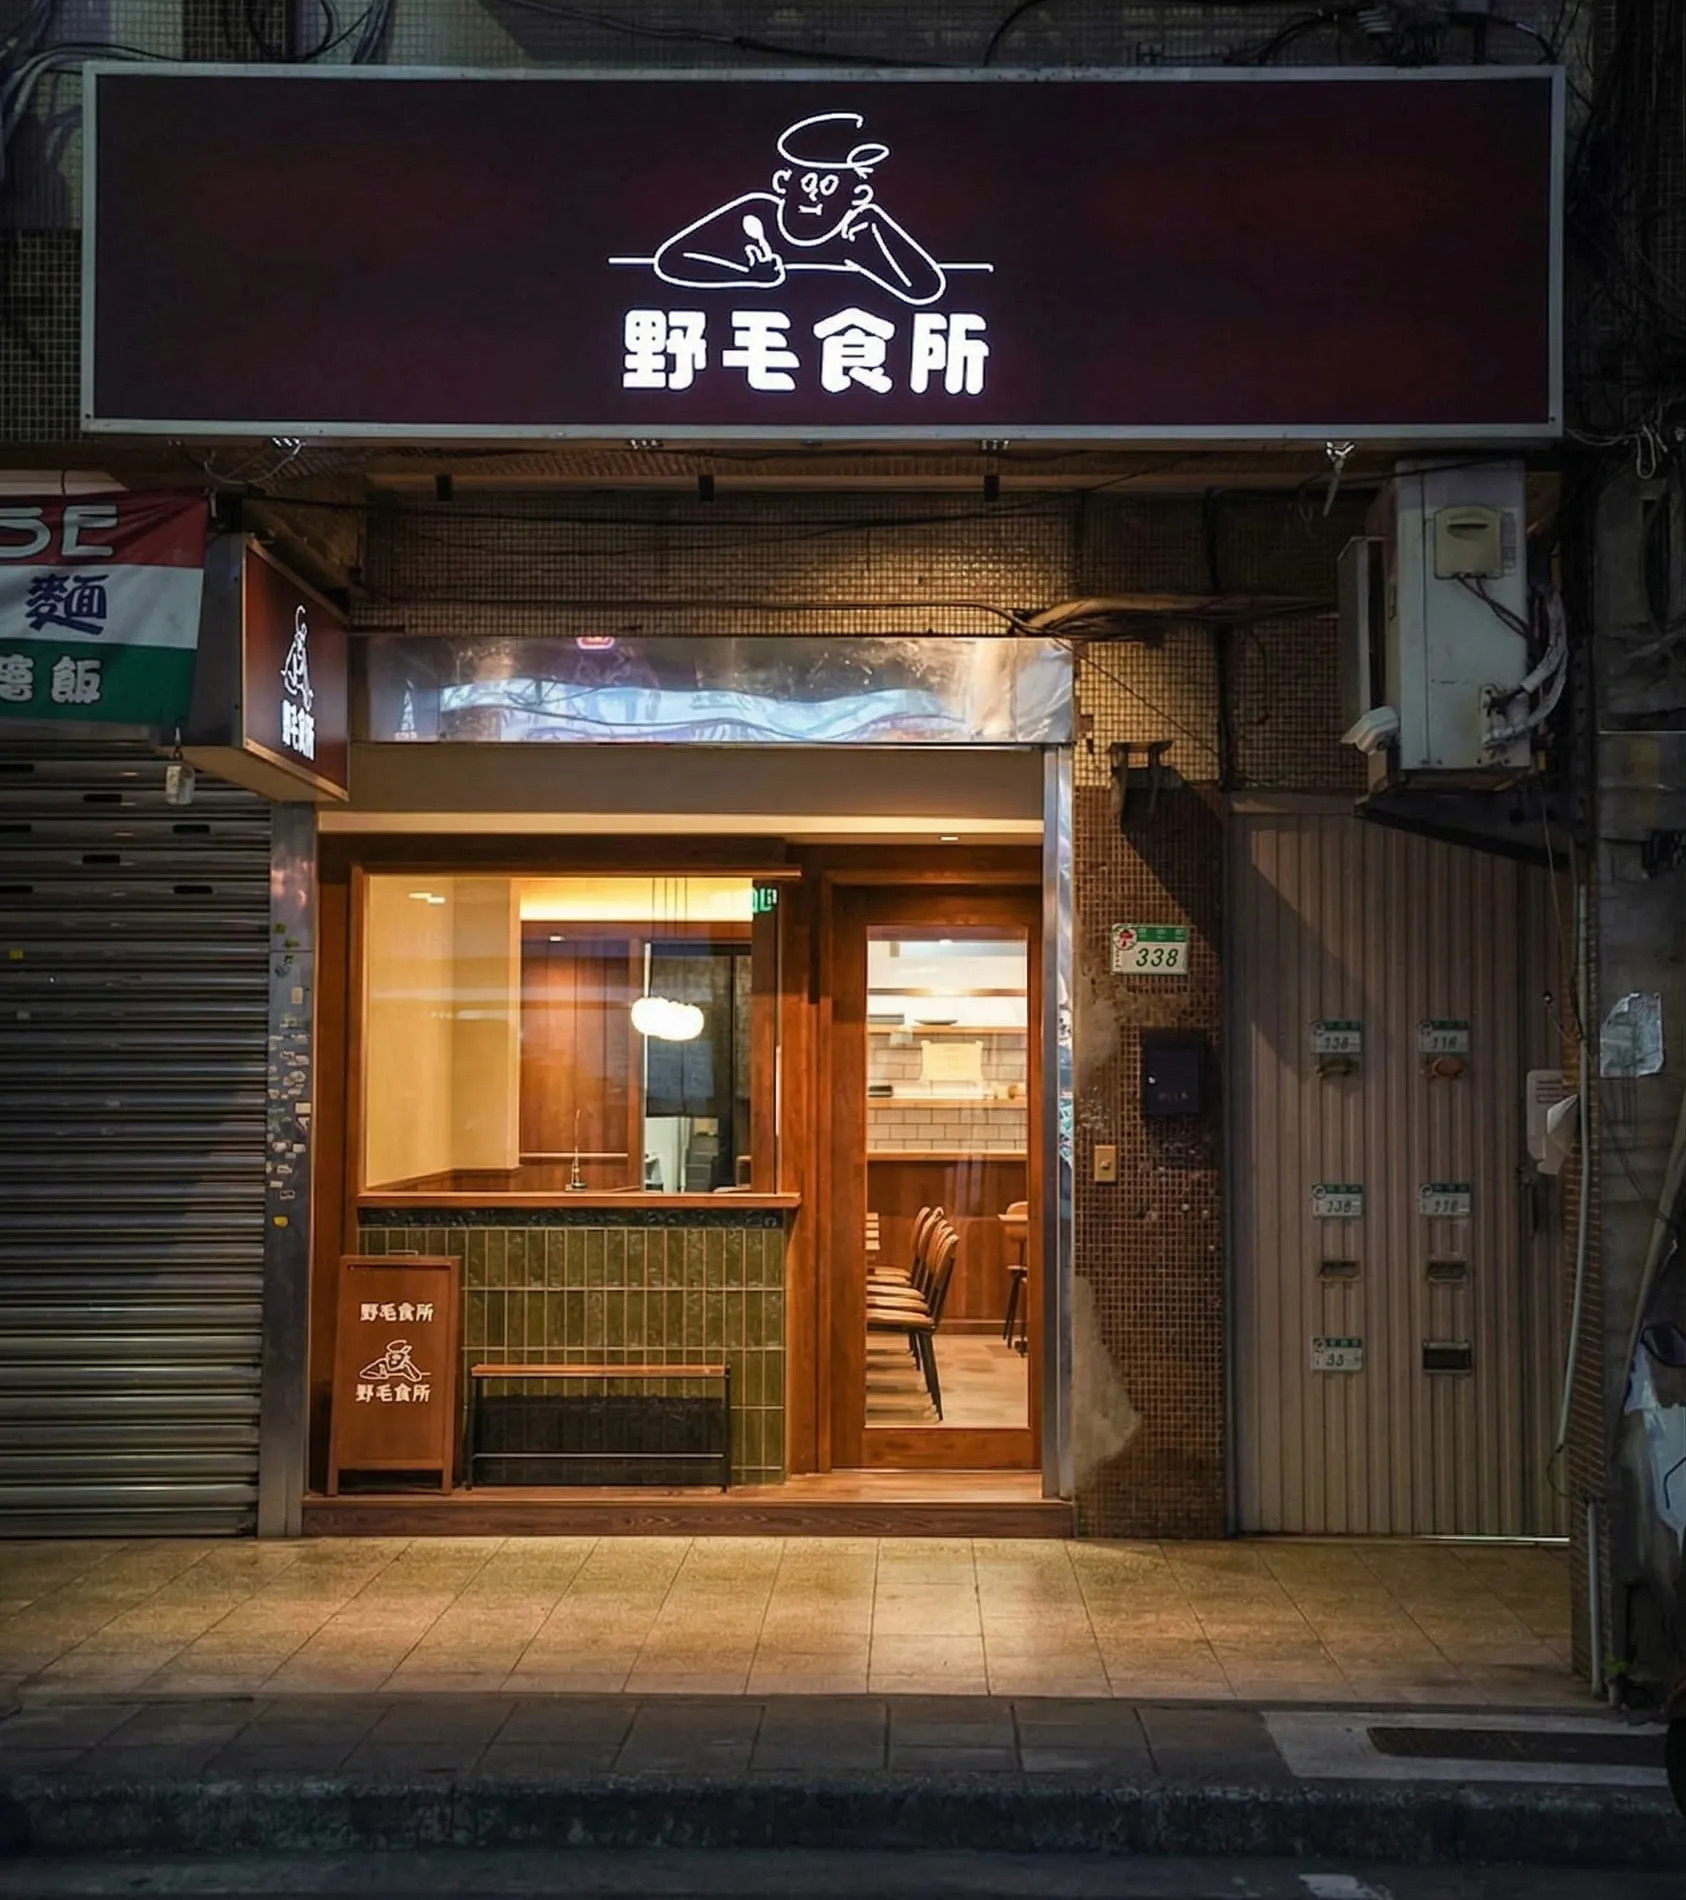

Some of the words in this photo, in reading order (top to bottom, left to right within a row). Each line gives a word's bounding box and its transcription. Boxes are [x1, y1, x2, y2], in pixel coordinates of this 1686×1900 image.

[622, 308, 991, 395] 野毛食所
[25, 574, 109, 635] 麵
[1135, 947, 1179, 967] 338
[360, 1302, 434, 1321] 野毛食所
[355, 1383, 431, 1402] 野毛食所
